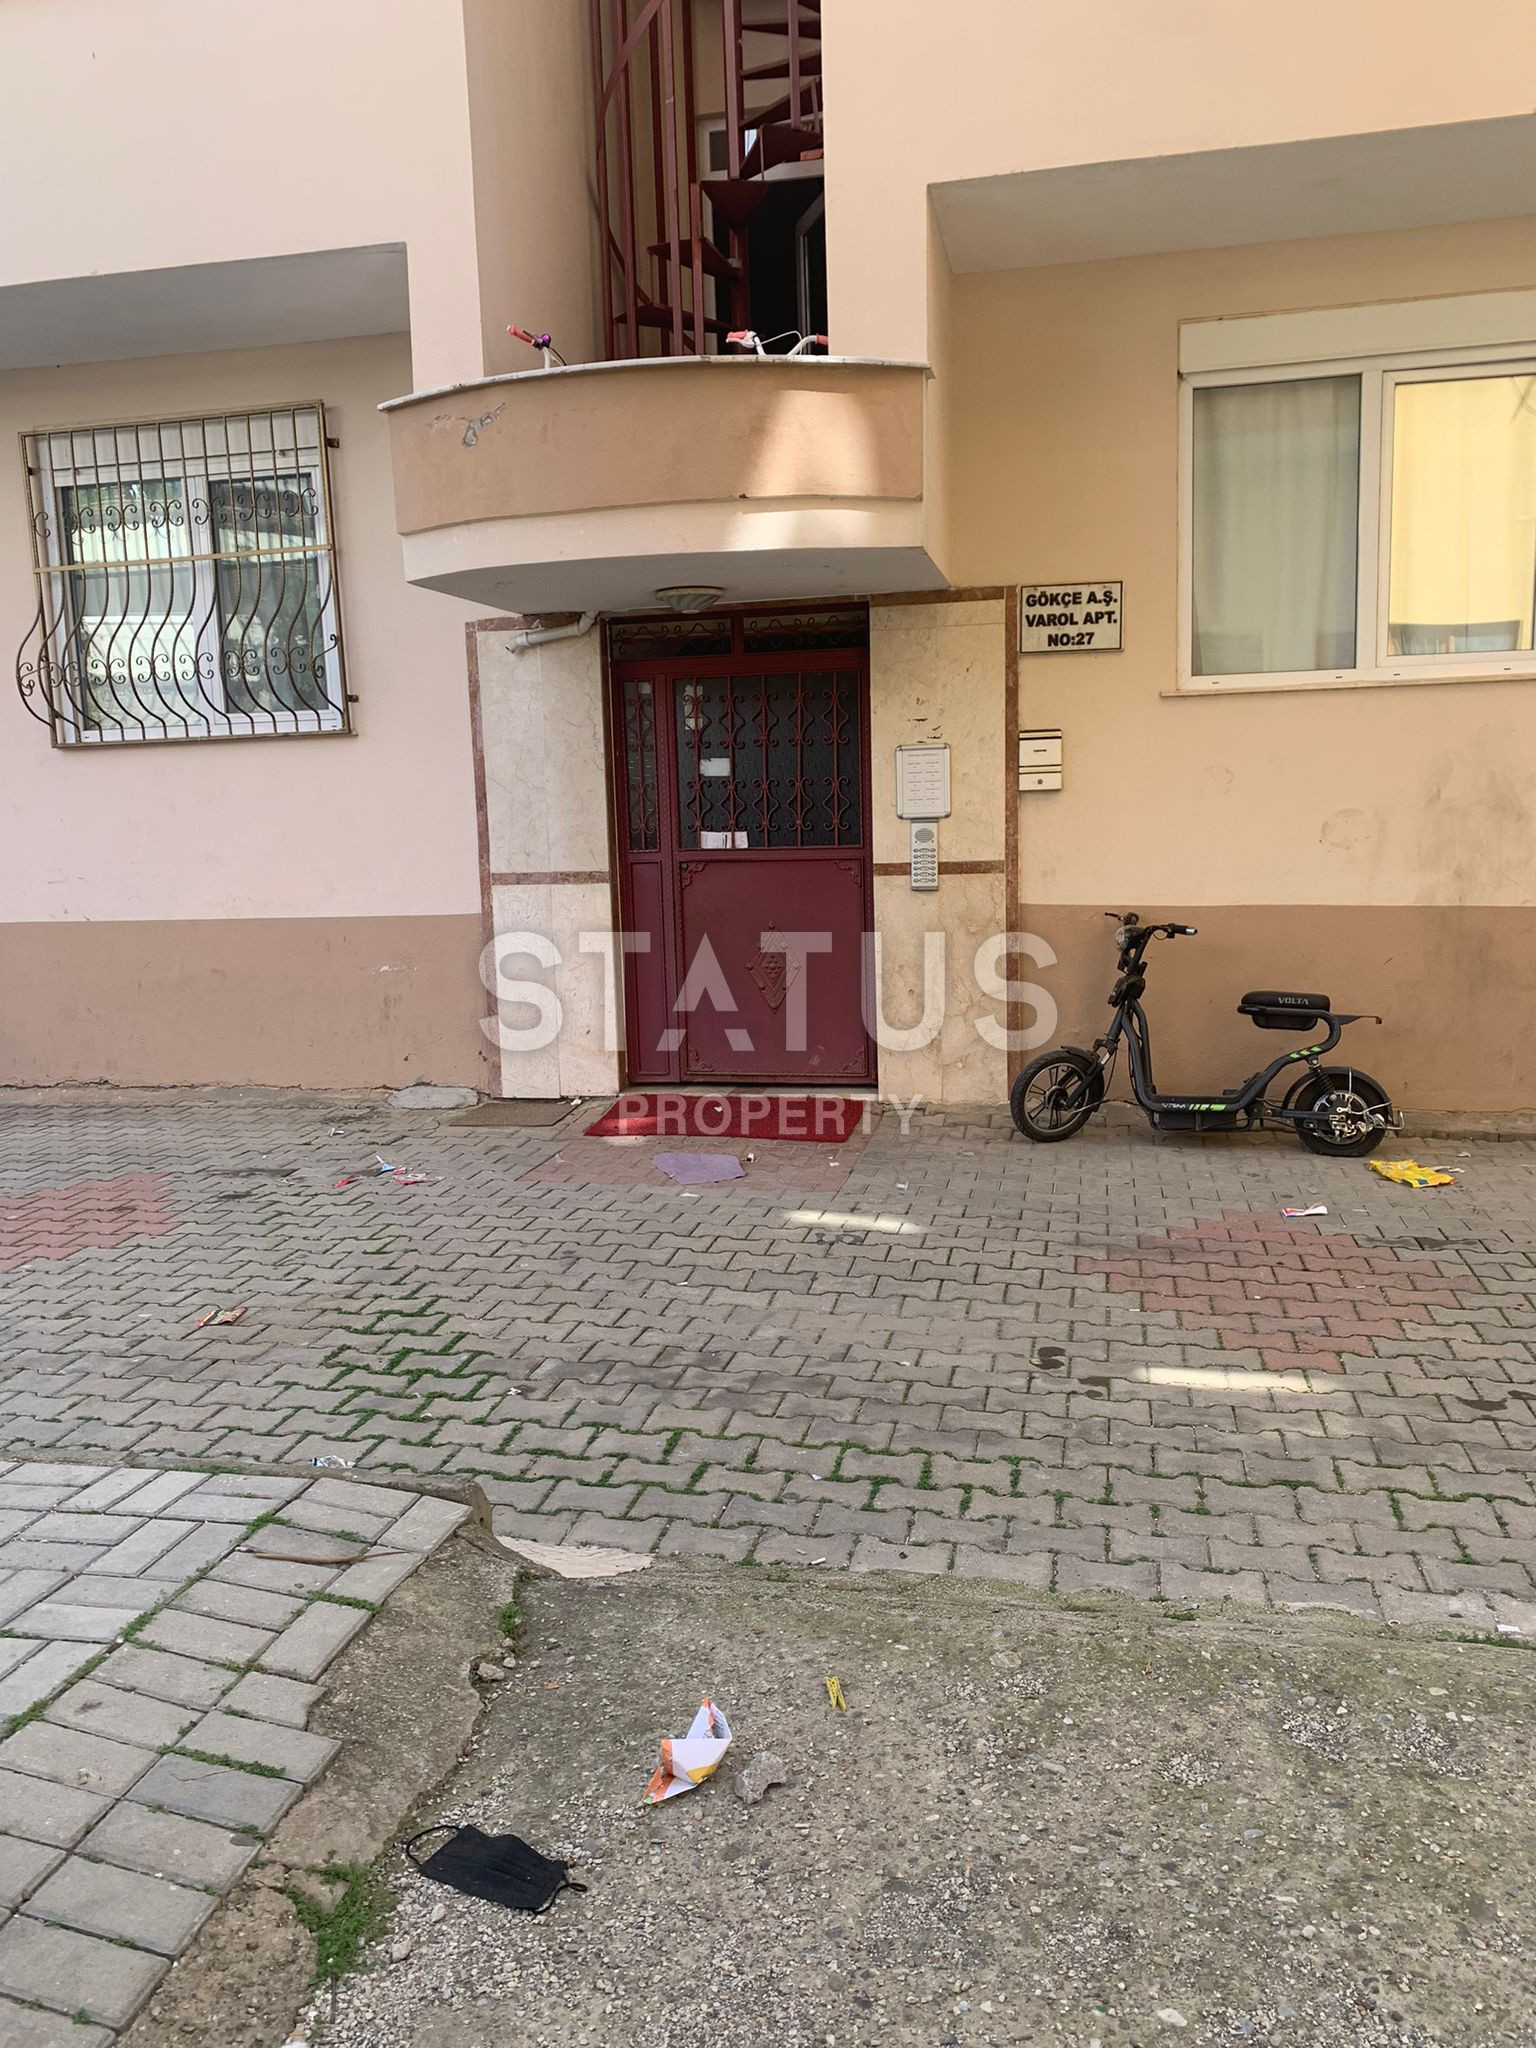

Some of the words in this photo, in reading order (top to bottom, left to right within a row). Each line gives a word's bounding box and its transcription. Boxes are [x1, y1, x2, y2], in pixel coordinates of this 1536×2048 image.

[1025, 591, 1082, 608] GÖKÇE
[1087, 590, 1118, 607] A.Ş.
[1025, 613, 1079, 627] VAROL
[1083, 611, 1118, 625] APT.
[1047, 632, 1095, 647] NO:27
[1278, 997, 1309, 1005] VOLTA
